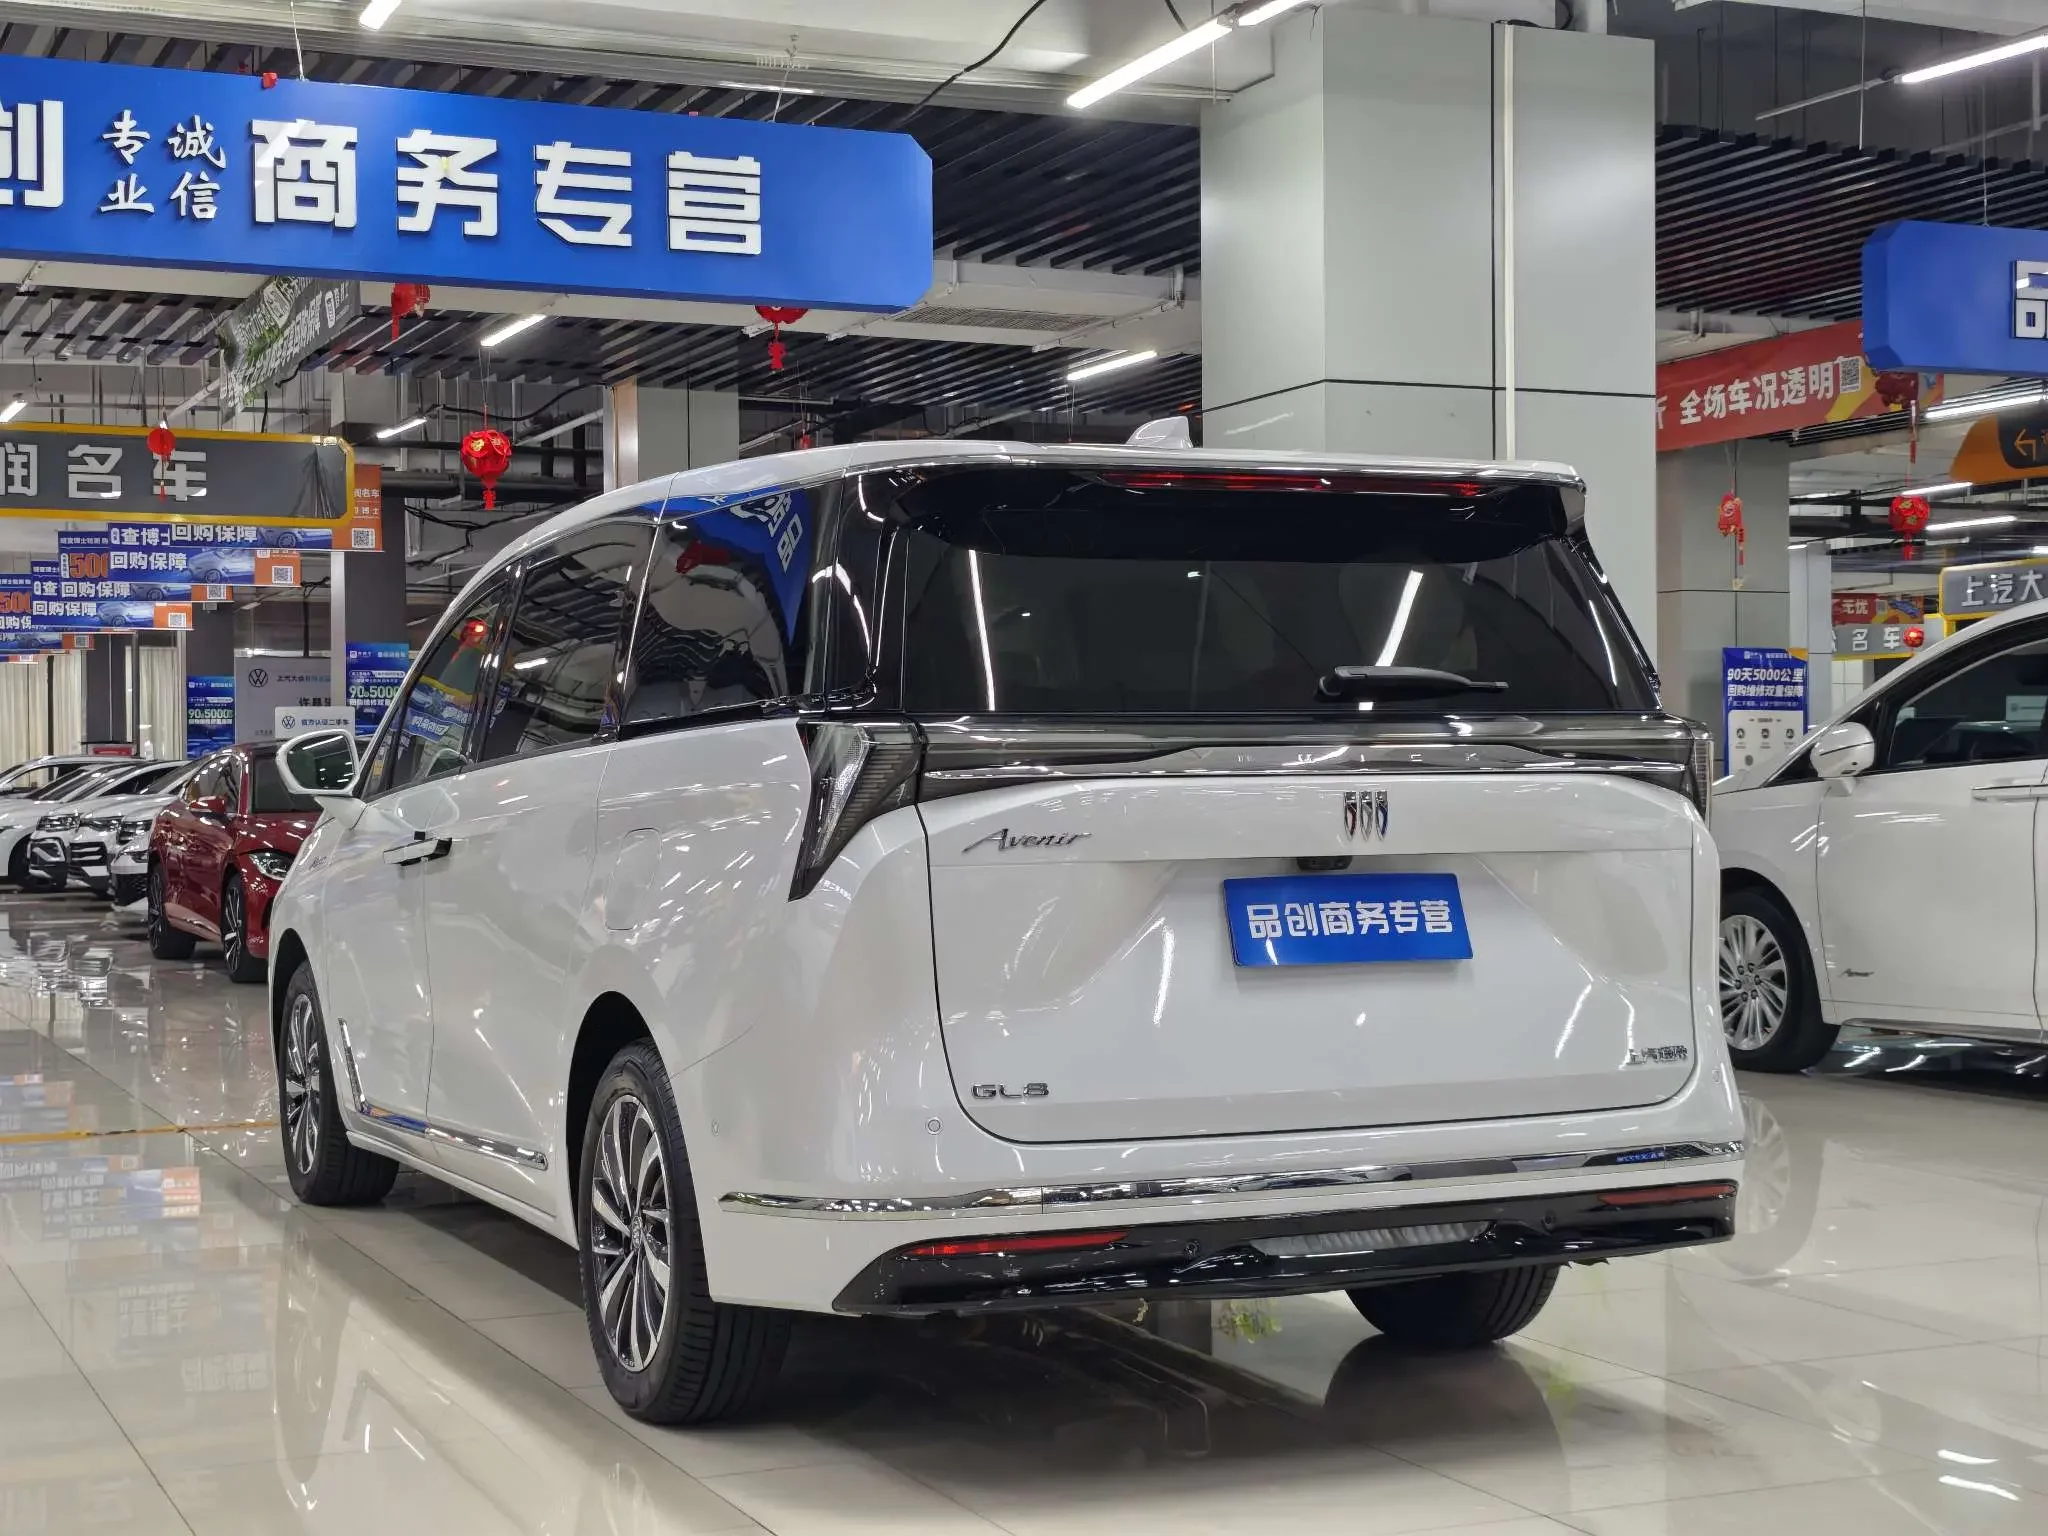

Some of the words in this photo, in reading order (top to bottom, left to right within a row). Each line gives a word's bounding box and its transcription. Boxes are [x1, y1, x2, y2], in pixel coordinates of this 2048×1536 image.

[250, 118, 762, 255] 商务专营
[172, 525, 258, 543] 回购保障
[110, 551, 188, 570] 回购保障
[61, 581, 131, 598] 回购保障
[32, 600, 97, 617] 回购保障
[1727, 667, 1804, 682] 90天5000公里
[961, 828, 1093, 853] Avenir
[1246, 899, 1454, 940] 品创商务专营
[972, 1082, 1050, 1100] GL8
